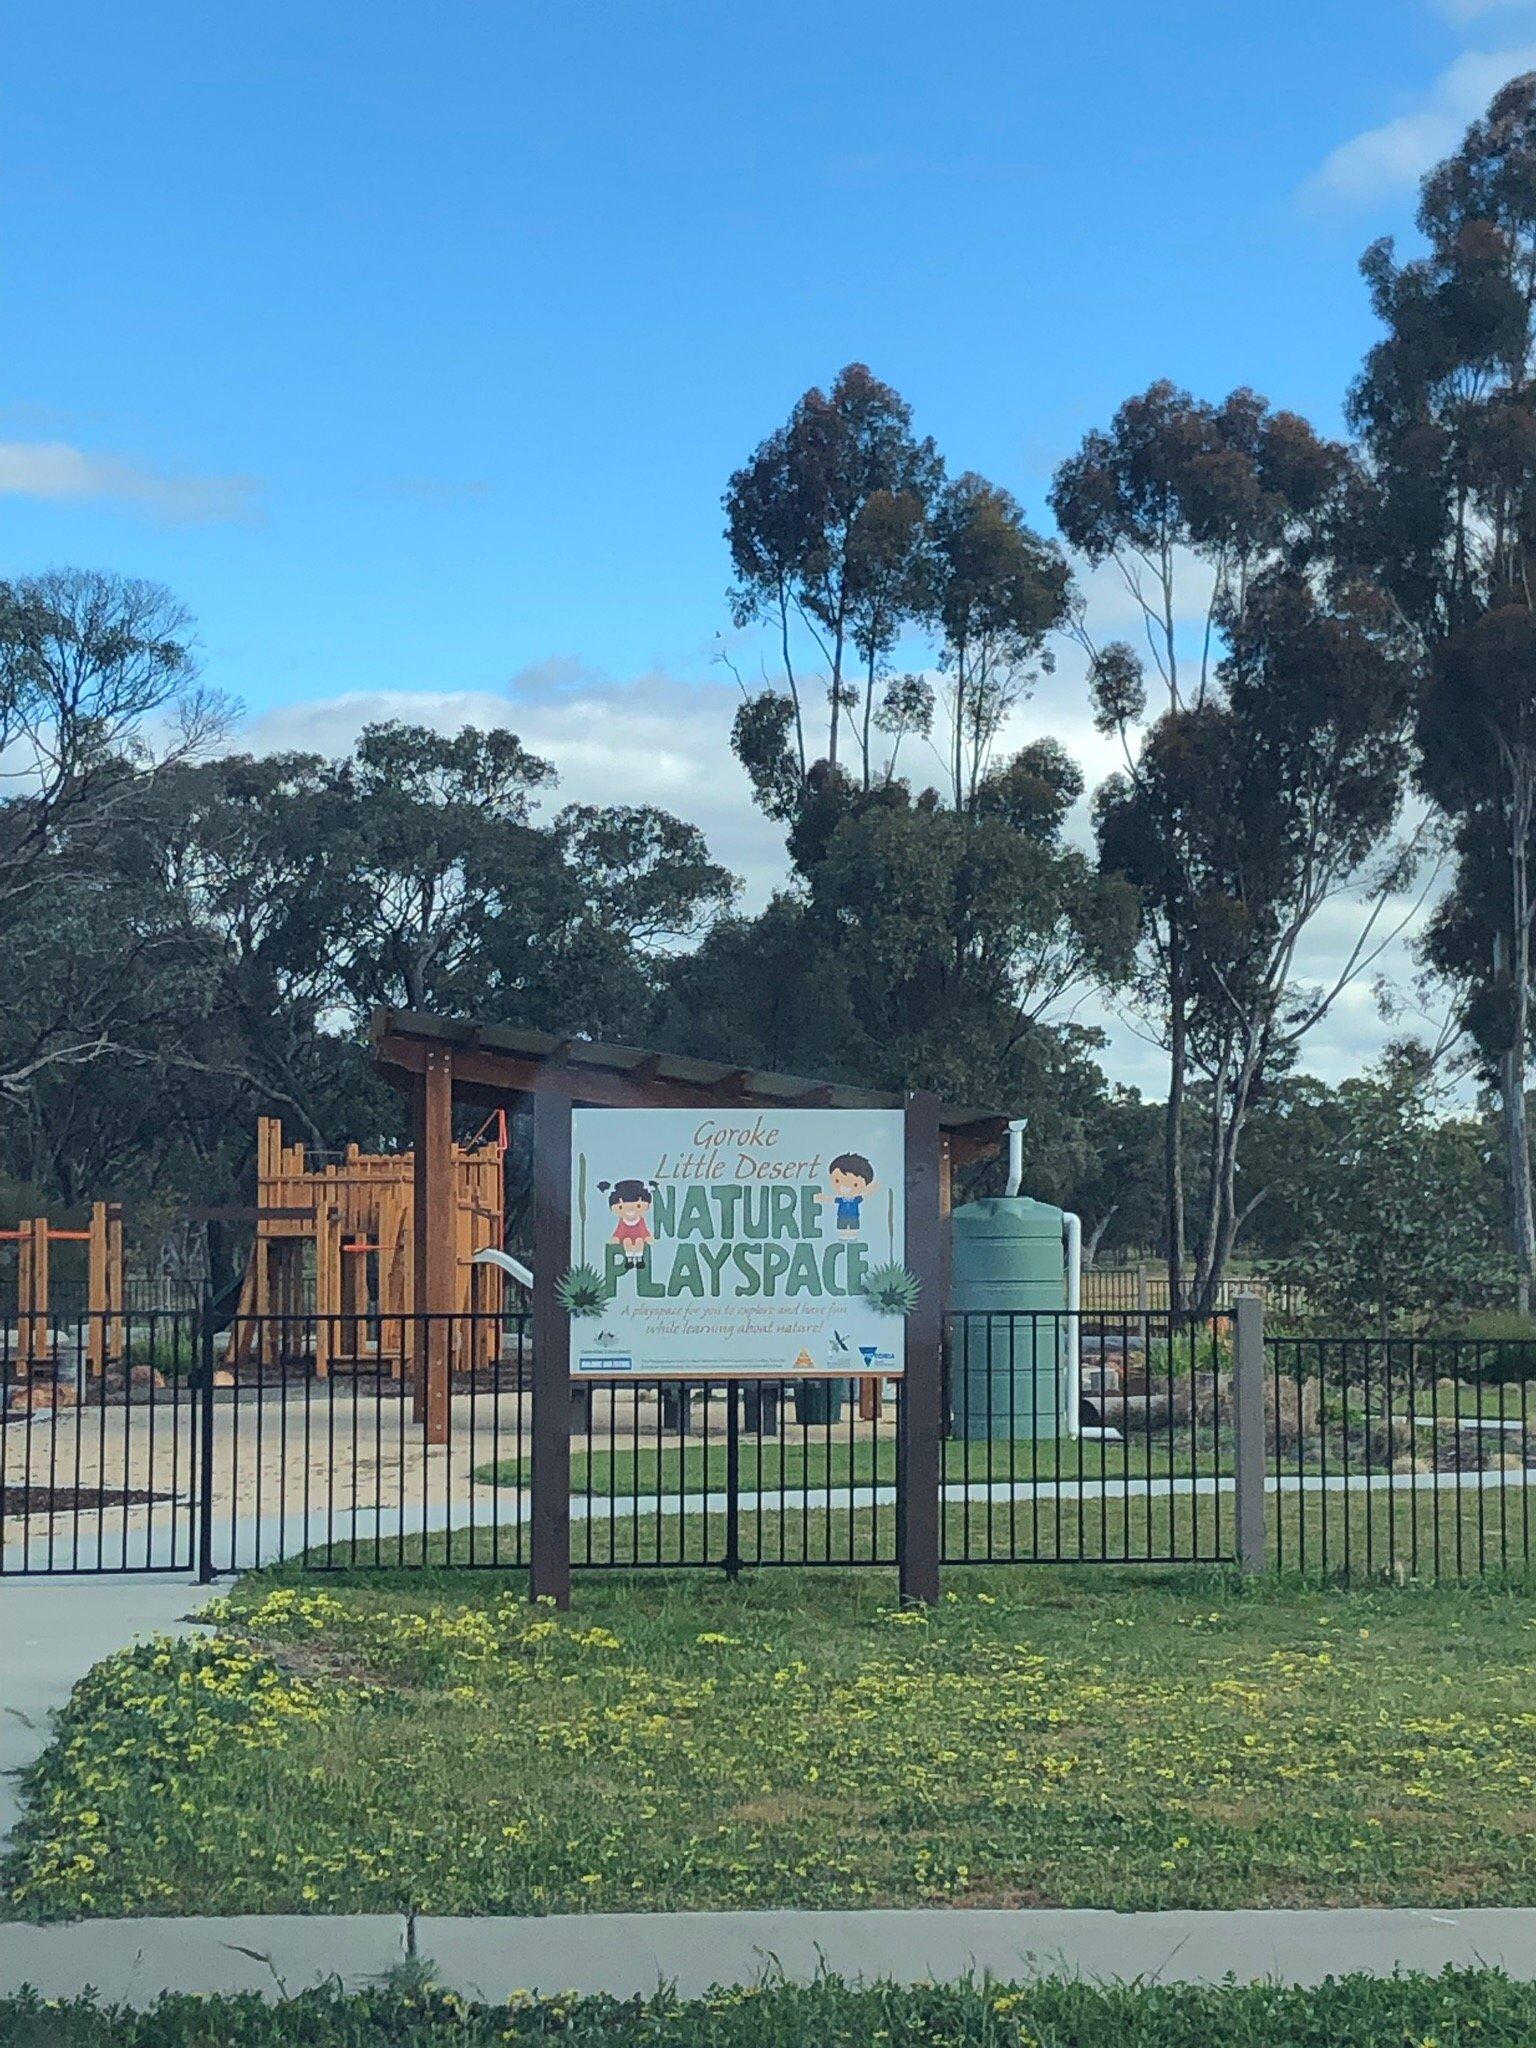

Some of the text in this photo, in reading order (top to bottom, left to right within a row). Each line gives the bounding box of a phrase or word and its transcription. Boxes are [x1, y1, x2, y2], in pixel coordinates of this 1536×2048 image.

[694, 1116, 779, 1149] Goroke
[655, 1149, 821, 1179] Little Desert
[652, 1184, 823, 1239] NATURE
[603, 1242, 869, 1298] PLAYSPACE
[621, 1304, 629, 1315] A
[684, 1302, 701, 1320] for
[701, 1307, 721, 1320] you
[724, 1305, 735, 1316] to
[777, 1302, 800, 1316] and
[827, 1301, 848, 1320] fun
[646, 1320, 679, 1334] while
[682, 1319, 736, 1341] learning
[738, 1320, 774, 1334] about
